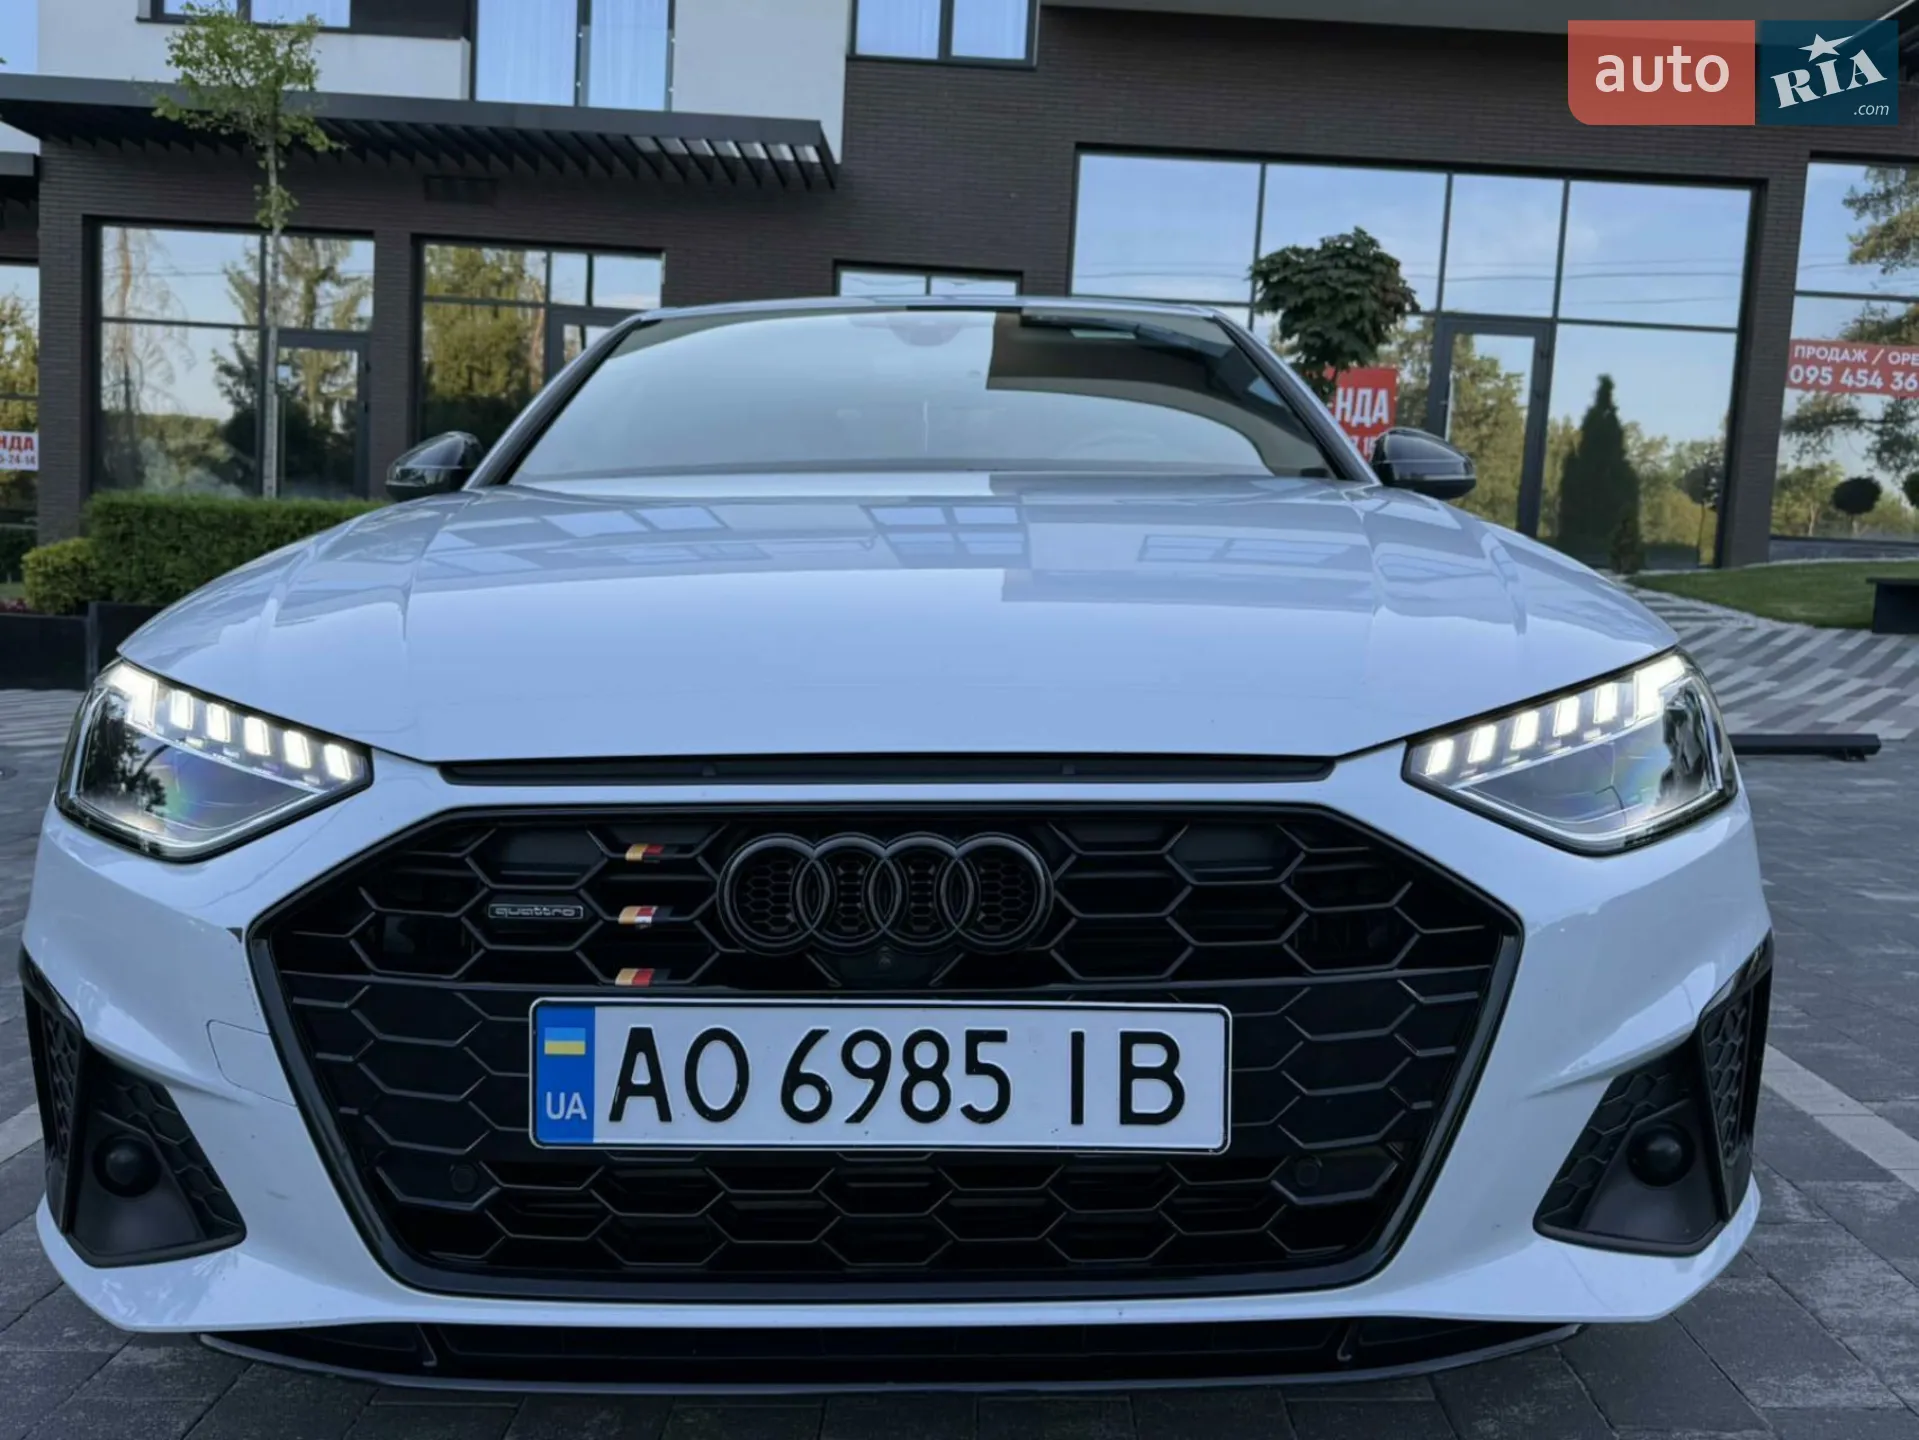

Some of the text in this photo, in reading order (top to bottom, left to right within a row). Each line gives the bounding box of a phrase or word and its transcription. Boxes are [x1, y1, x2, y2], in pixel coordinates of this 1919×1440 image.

[1793, 344, 1868, 363] ПРОДАЖ
[1789, 364, 1919, 392] 095 454 36
[495, 907, 576, 918] quattro
[608, 1026, 1187, 1126] AO 6985 IB
[545, 1091, 588, 1122] UA
